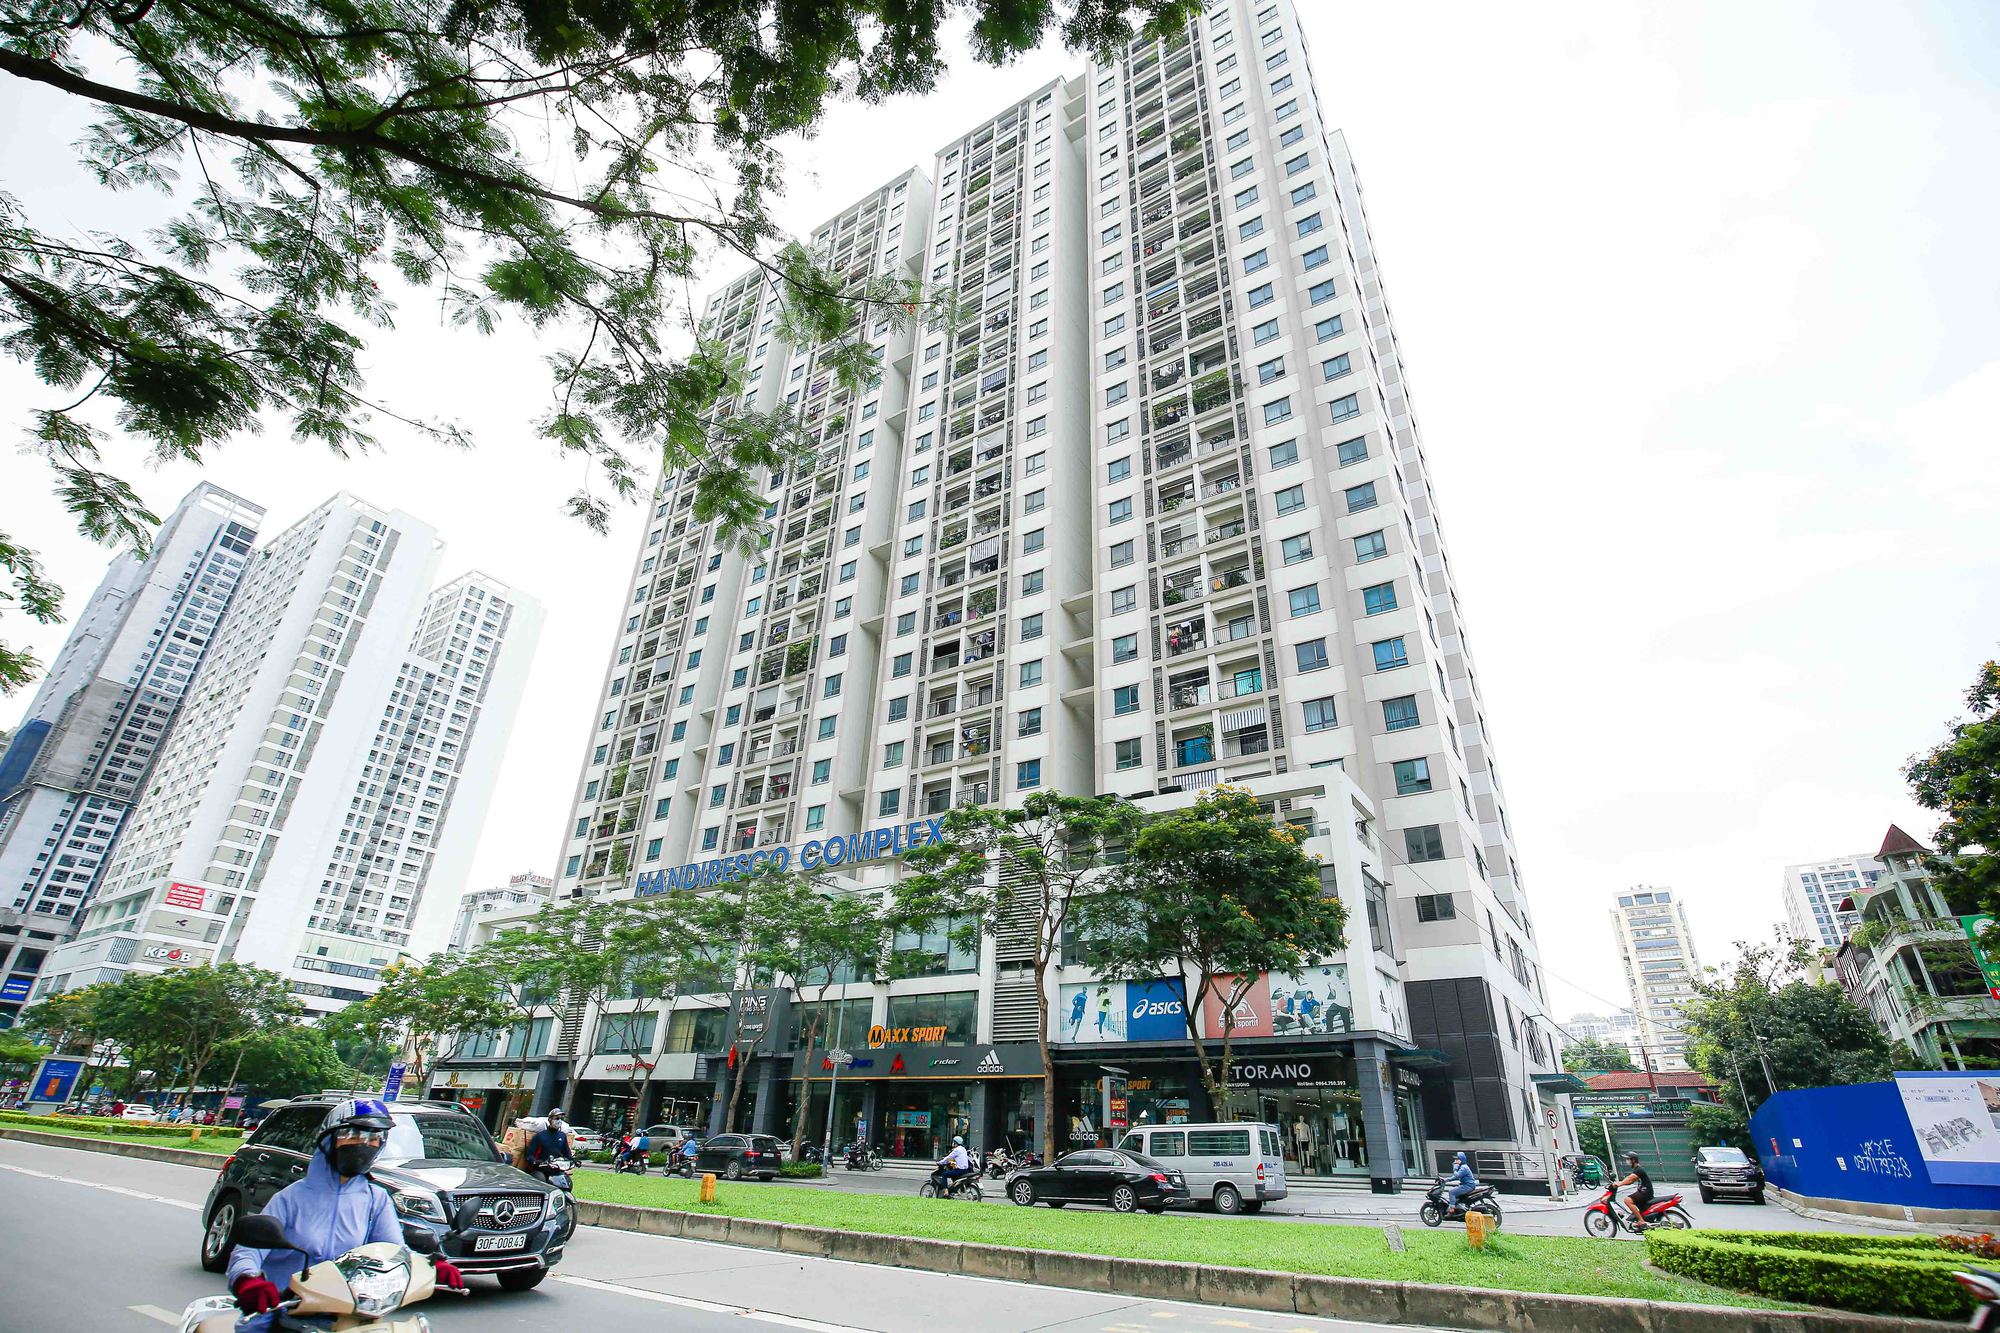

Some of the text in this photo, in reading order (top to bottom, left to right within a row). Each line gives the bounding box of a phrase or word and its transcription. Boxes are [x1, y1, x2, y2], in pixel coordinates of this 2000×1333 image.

[634, 816, 946, 898] HANDIRESCO COMPLEX
[1148, 1002, 1182, 1015] asics
[868, 1025, 947, 1048] MAXX SPORT
[977, 1063, 1004, 1073] adidas
[1232, 1064, 1311, 1079] TORANO
[1127, 1080, 1152, 1090] SPORT
[1069, 1131, 1099, 1141] adidas
